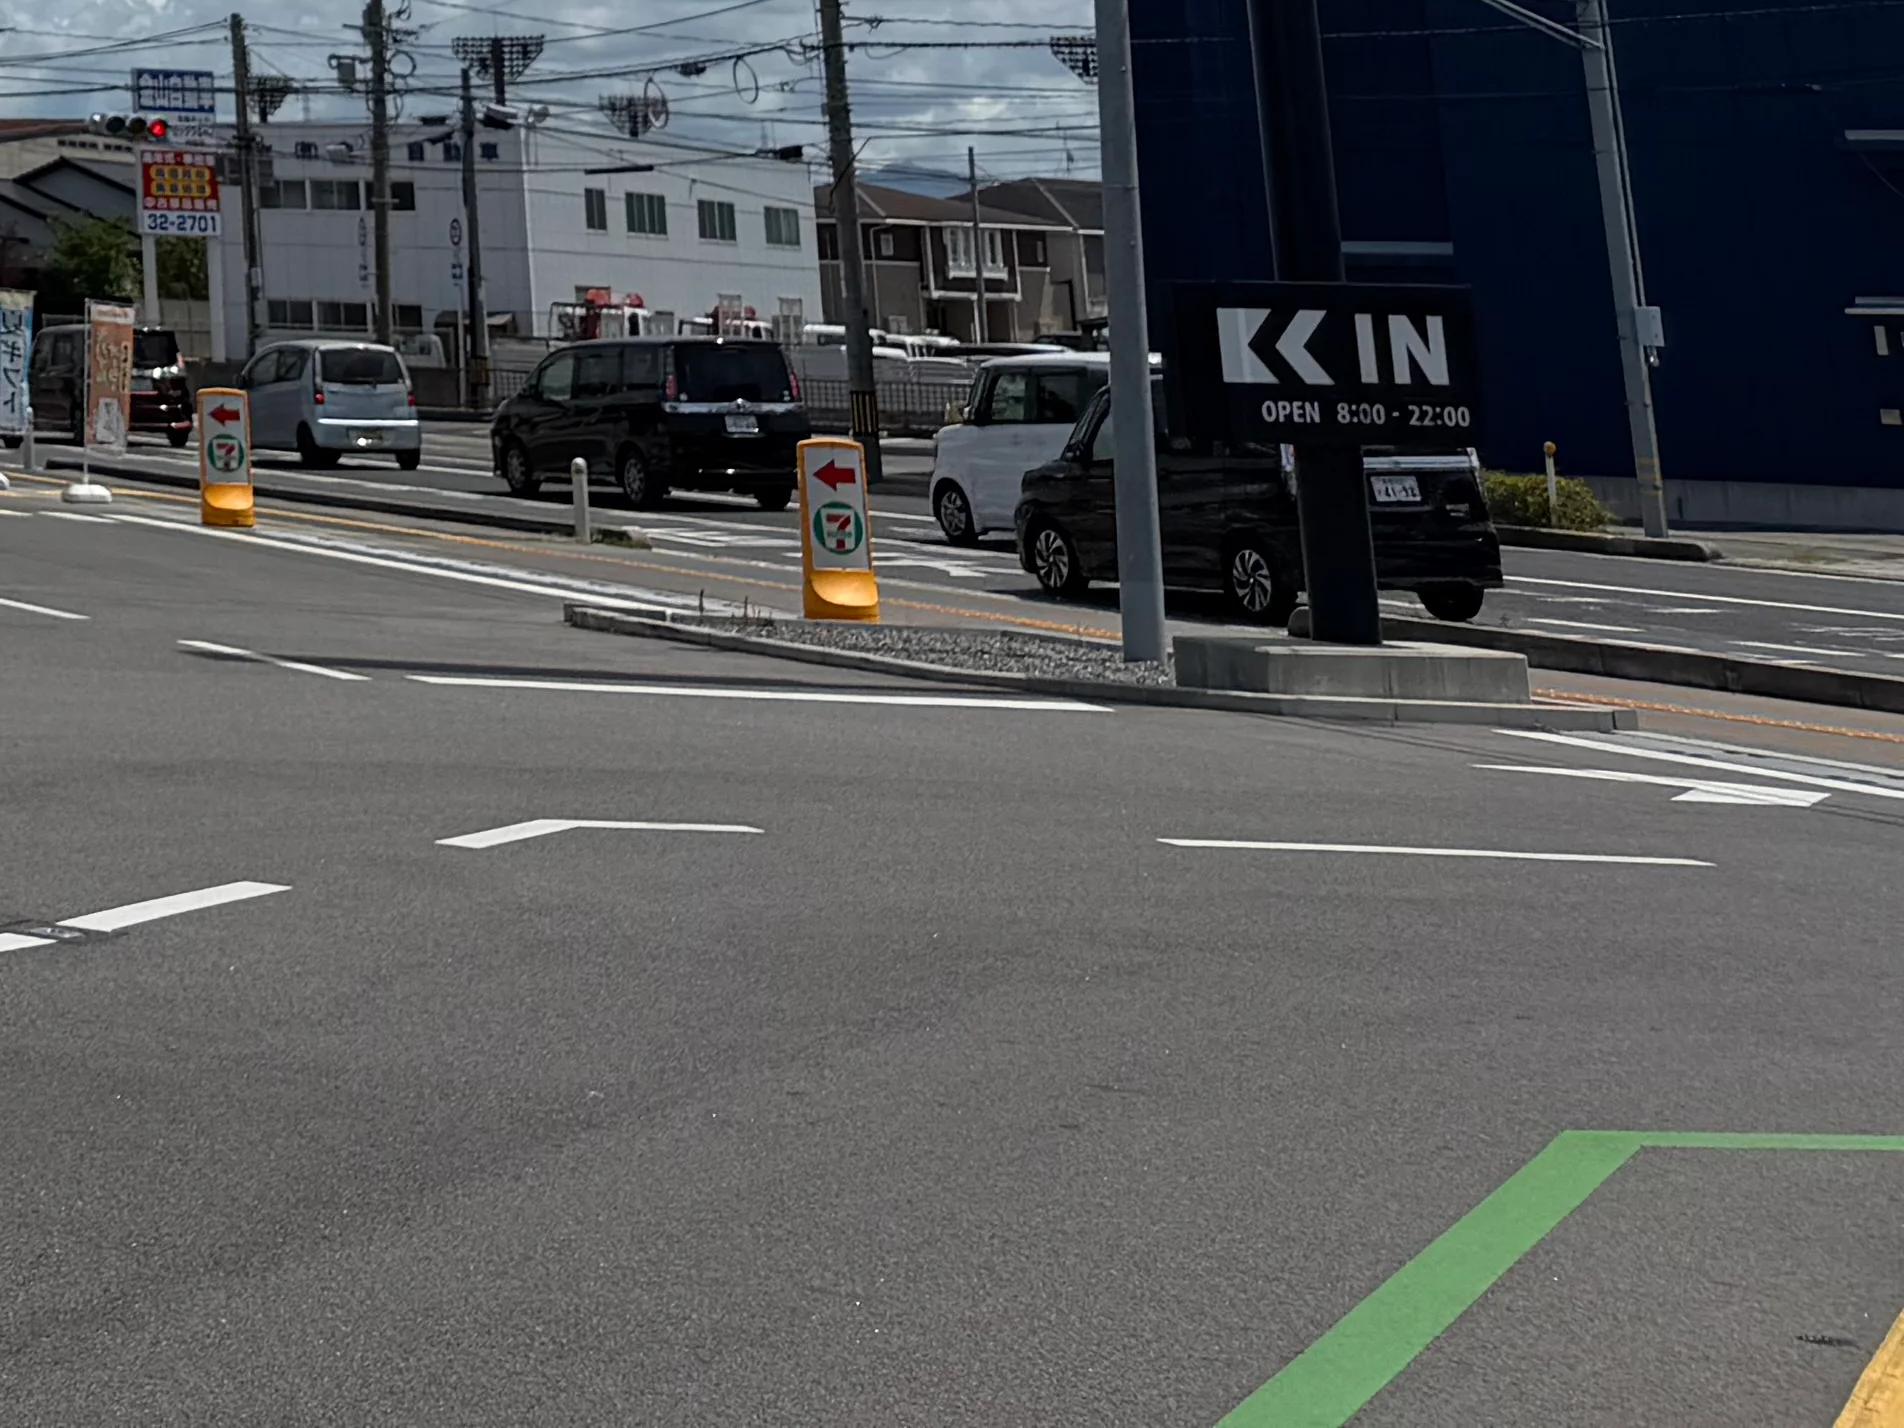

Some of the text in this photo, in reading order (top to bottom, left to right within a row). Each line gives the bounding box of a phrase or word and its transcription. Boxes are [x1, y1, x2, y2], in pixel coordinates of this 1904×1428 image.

[147, 213, 217, 233] 32-2701
[1354, 312, 1450, 386] IN
[1261, 400, 1321, 424] OPEN
[1336, 402, 1386, 425] 8:00
[1407, 404, 1471, 428] 22:00
